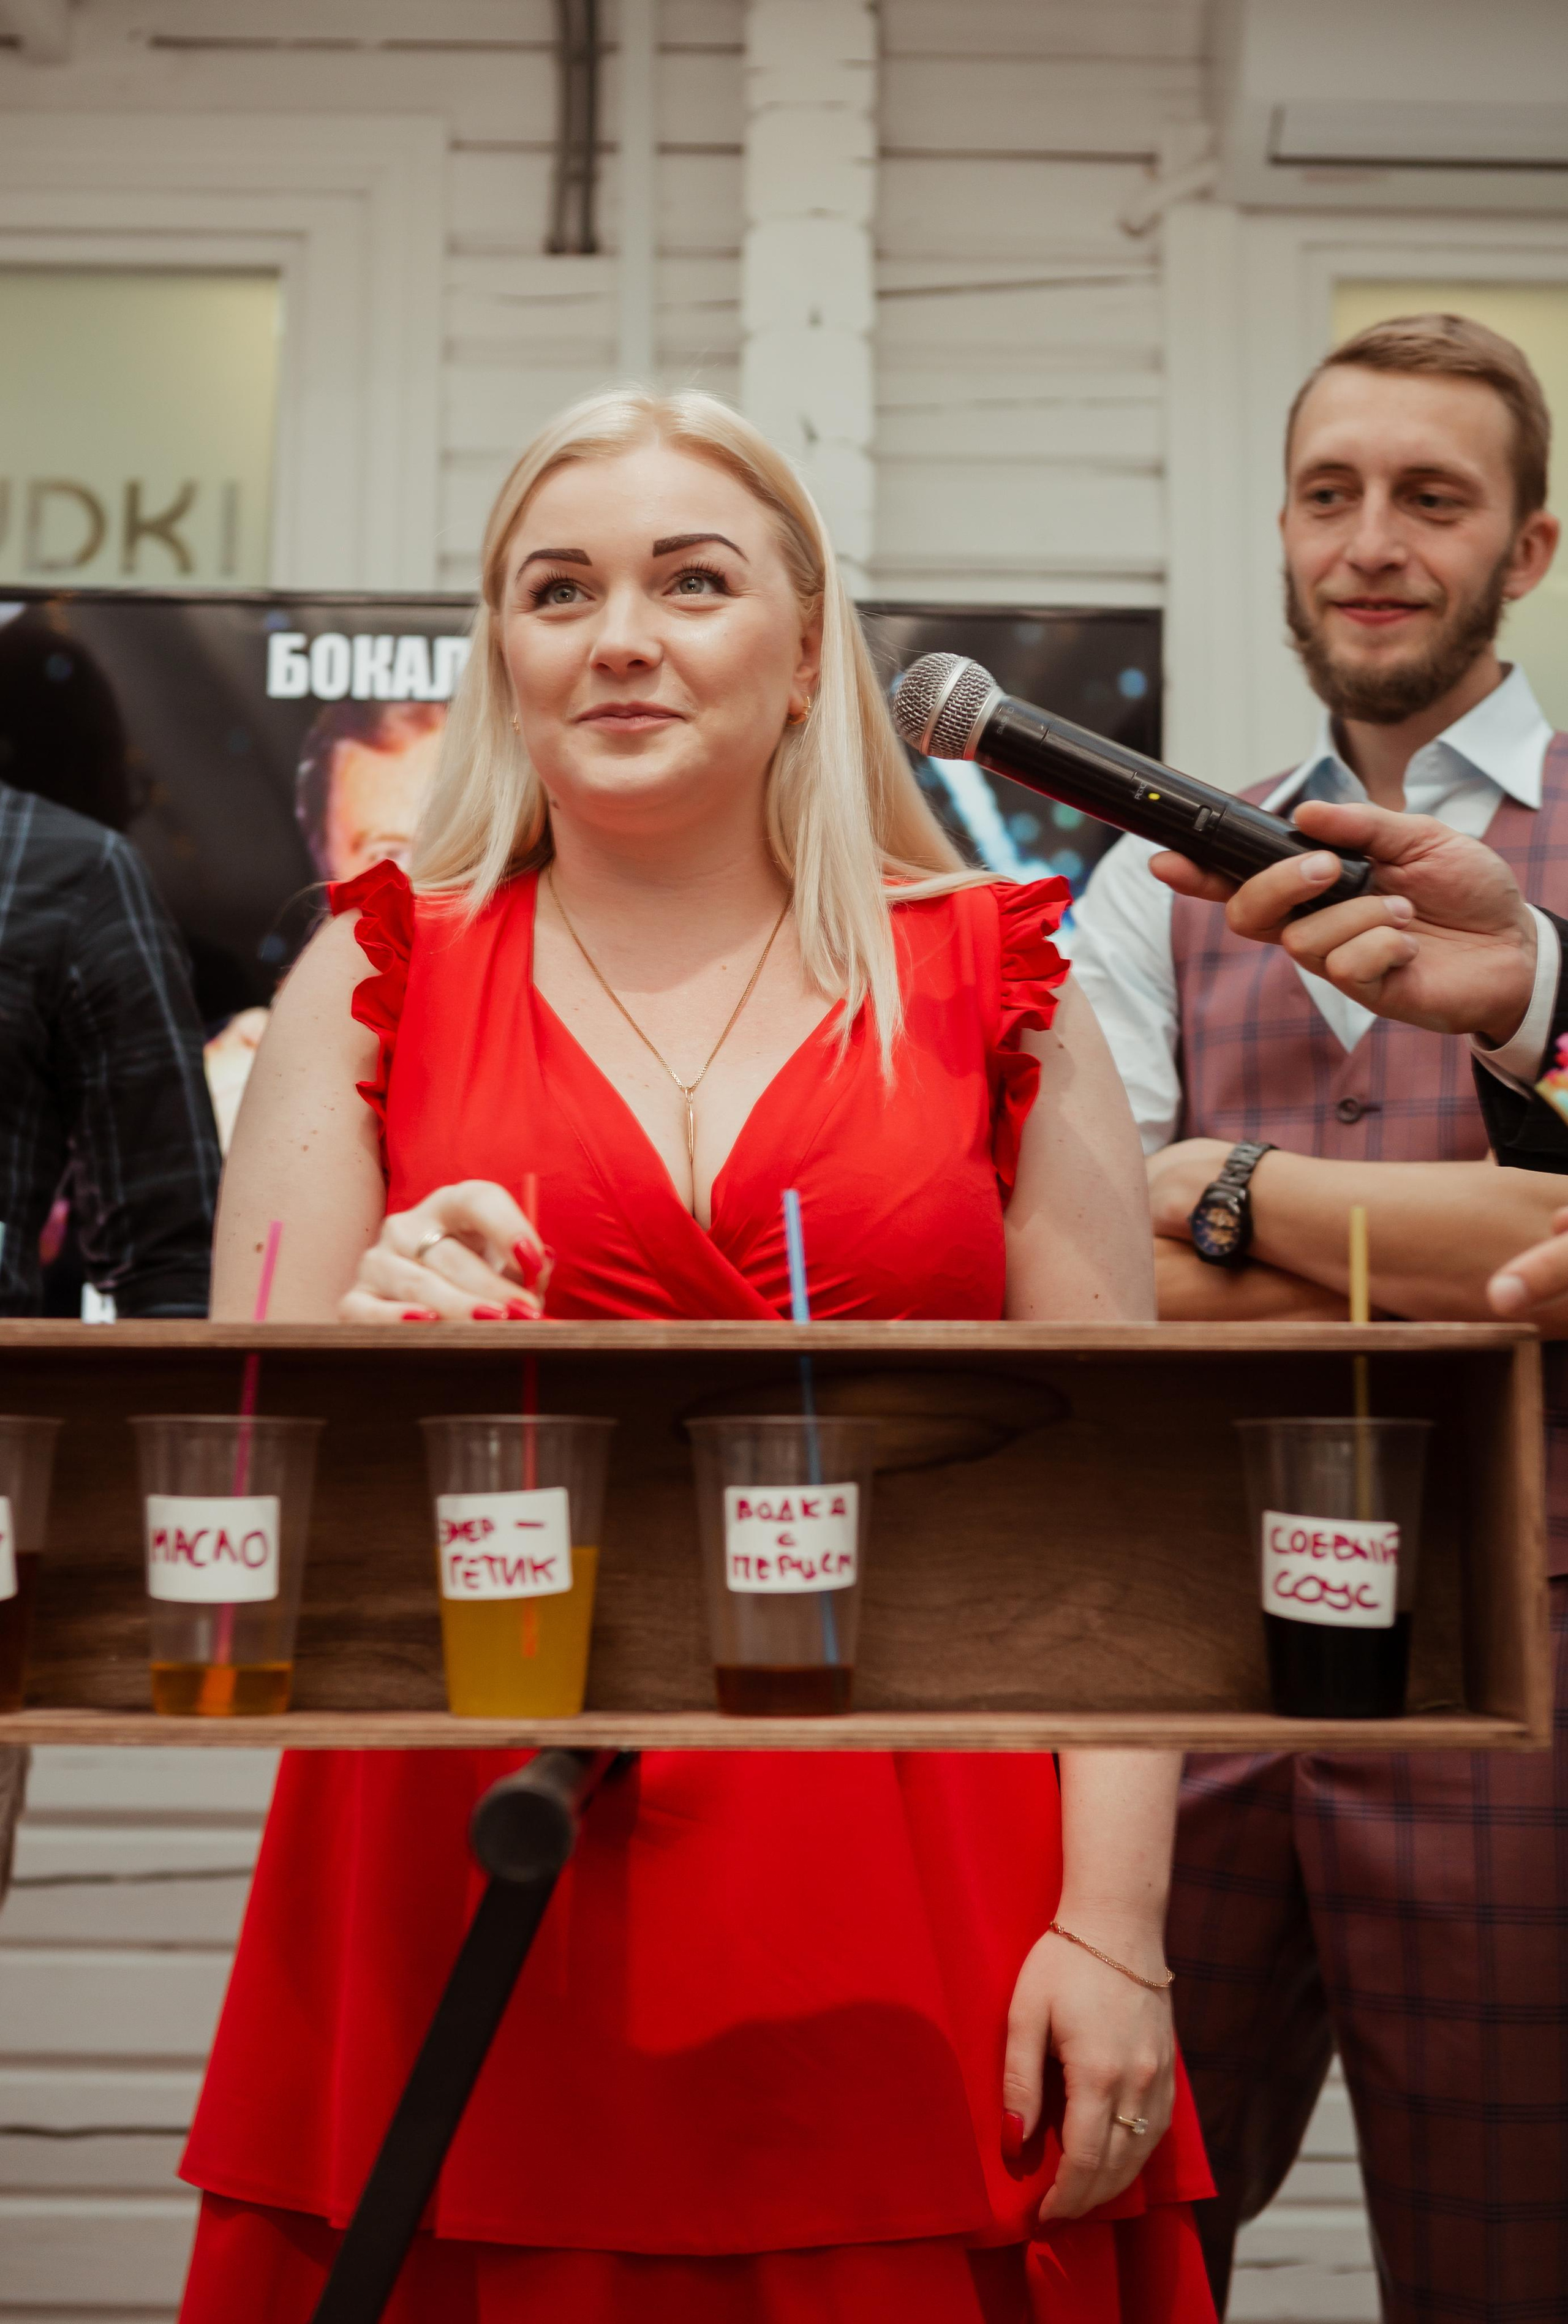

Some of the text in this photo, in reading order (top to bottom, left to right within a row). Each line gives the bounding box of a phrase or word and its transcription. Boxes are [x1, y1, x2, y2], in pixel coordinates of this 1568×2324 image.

[0, 478, 239, 575] DKI
[737, 1498, 846, 1522] ВОДКА
[151, 1528, 268, 1568] МАСЛО
[450, 1554, 557, 1588] ГЕТИК
[1273, 1570, 1380, 1610] СОУС
